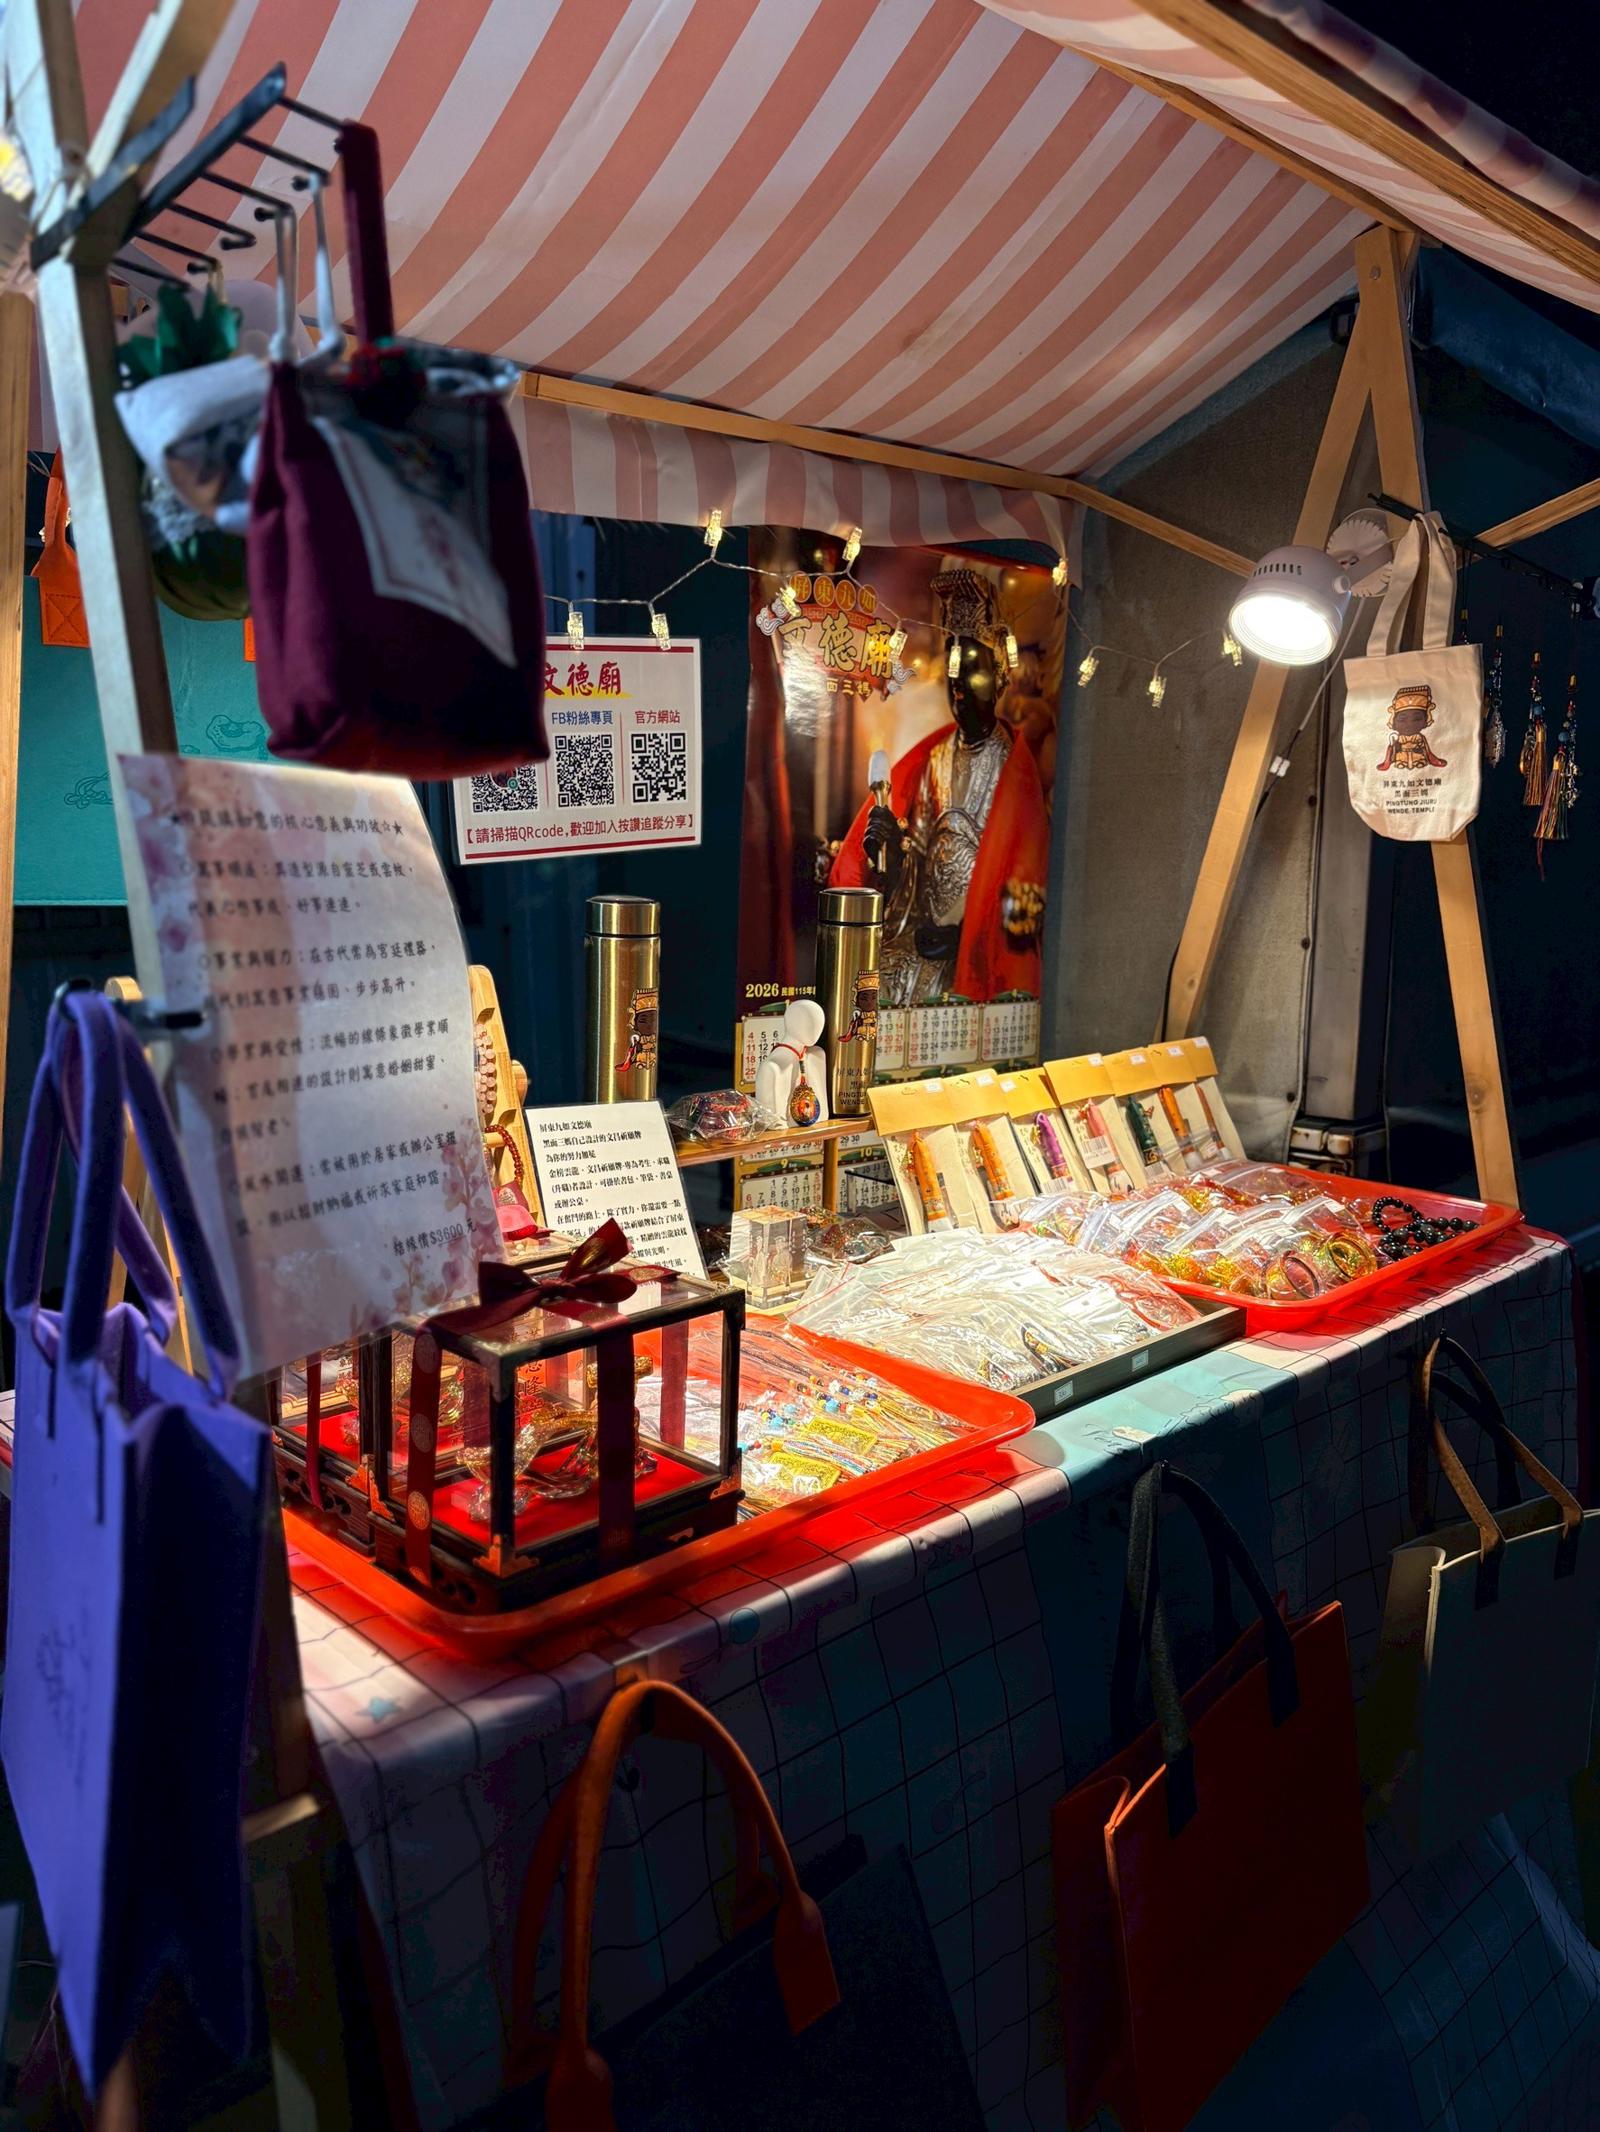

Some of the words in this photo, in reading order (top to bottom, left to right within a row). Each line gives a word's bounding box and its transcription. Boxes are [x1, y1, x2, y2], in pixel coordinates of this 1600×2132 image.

[794, 576, 877, 611] 屏東九如
[544, 661, 622, 697] 文德廟
[824, 676, 874, 696] 面三媽
[551, 710, 614, 725] FB粉絲專頁
[634, 710, 681, 725] 官方網站
[745, 983, 779, 998] 2026
[781, 985, 816, 997] 民國115年
[539, 1120, 592, 1133] 屏東九如文德廟
[860, 1147, 873, 1158] 10
[781, 1158, 789, 1169] 9
